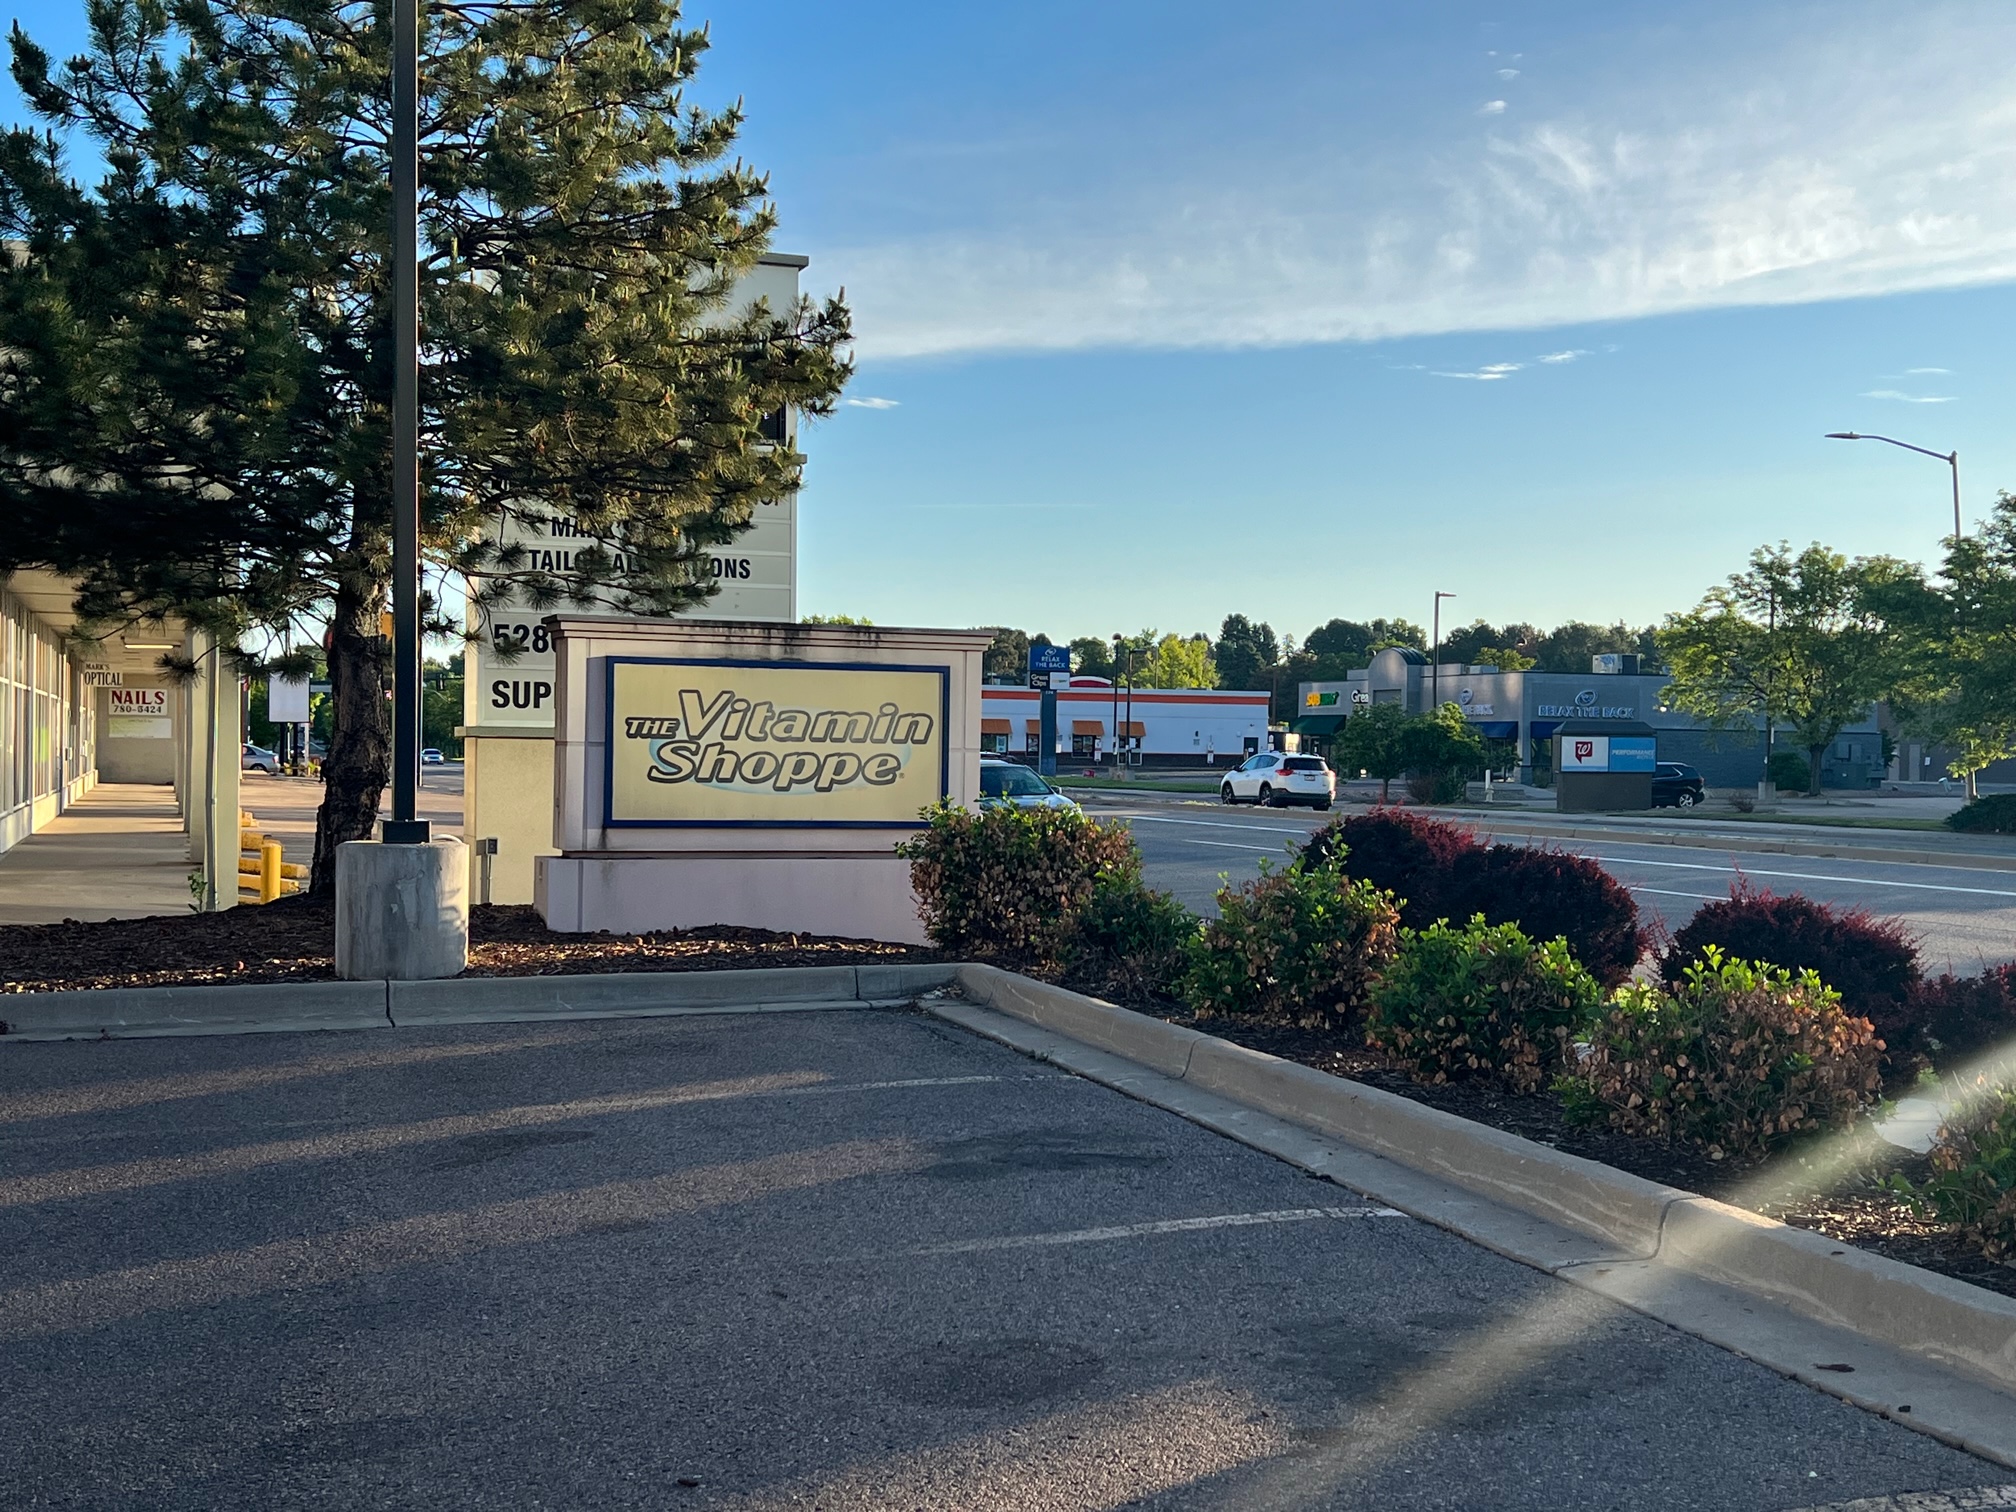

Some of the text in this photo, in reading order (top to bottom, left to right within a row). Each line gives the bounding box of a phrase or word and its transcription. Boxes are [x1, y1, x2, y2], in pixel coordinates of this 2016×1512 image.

[529, 549, 597, 571] TAIL
[84, 671, 122, 686] OPTICAL
[111, 690, 165, 705] NAILS
[492, 680, 557, 709] SUP
[1351, 689, 1369, 703] Grea
[625, 689, 934, 744] THE Vitamin
[1538, 705, 1635, 719] RELAX THE BACK
[647, 740, 901, 792] Shoppe
